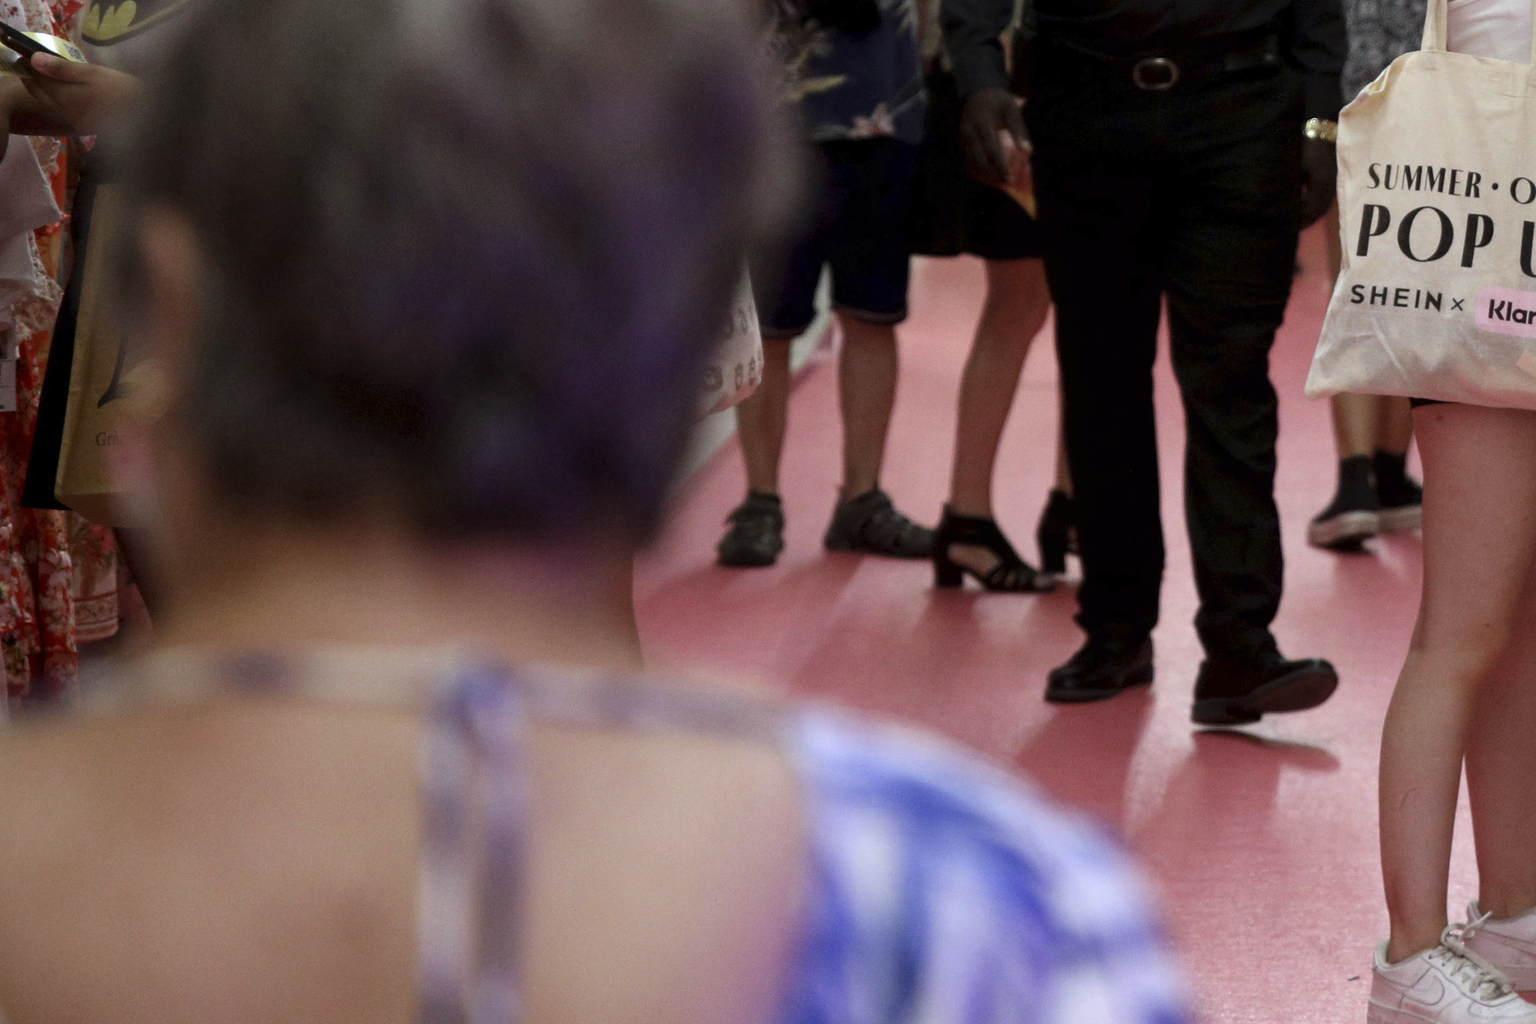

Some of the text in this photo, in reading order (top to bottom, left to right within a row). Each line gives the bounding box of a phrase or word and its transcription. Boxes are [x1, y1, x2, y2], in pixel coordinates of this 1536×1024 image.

[1367, 162, 1482, 199] SUMMER
[1356, 203, 1495, 269] POP
[1349, 284, 1443, 313] SHEIN
